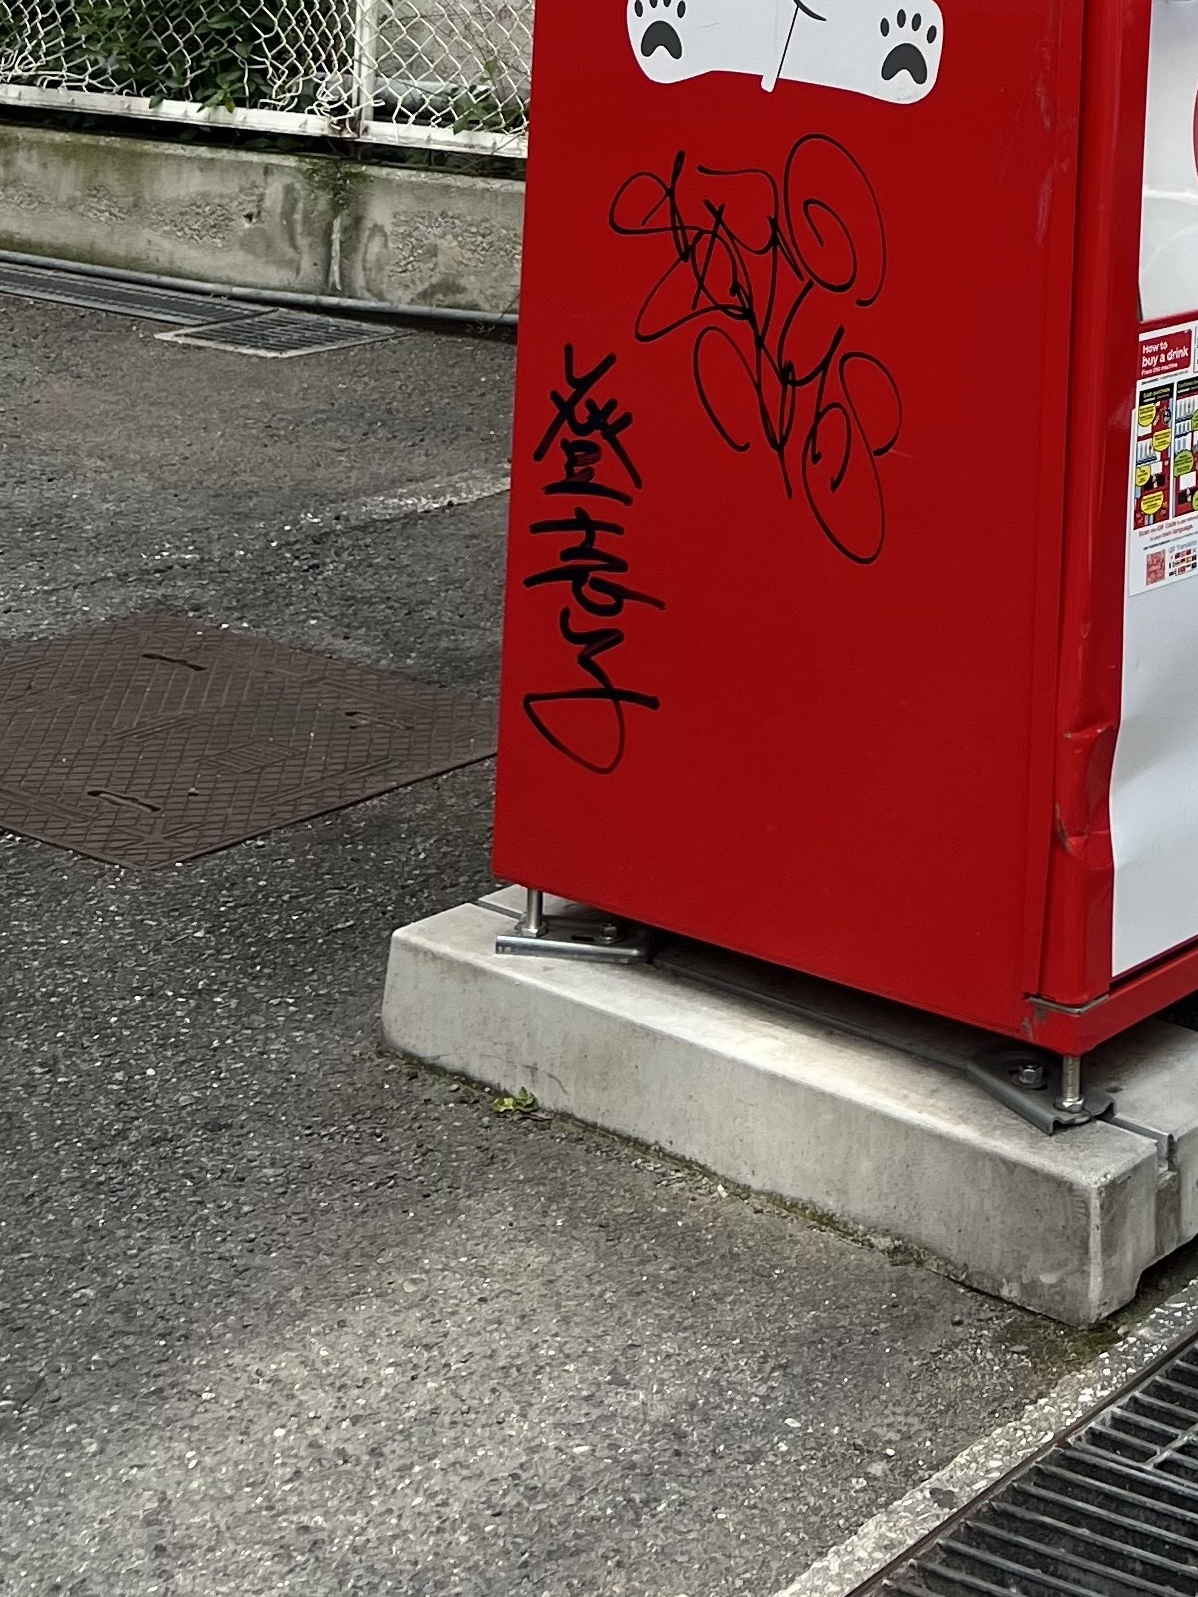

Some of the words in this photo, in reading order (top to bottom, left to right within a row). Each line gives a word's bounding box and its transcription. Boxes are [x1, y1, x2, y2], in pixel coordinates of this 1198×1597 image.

[1142, 344, 1159, 354] How
[1160, 341, 1168, 350] to
[1142, 355, 1159, 368] buy
[1166, 345, 1189, 361] drink
